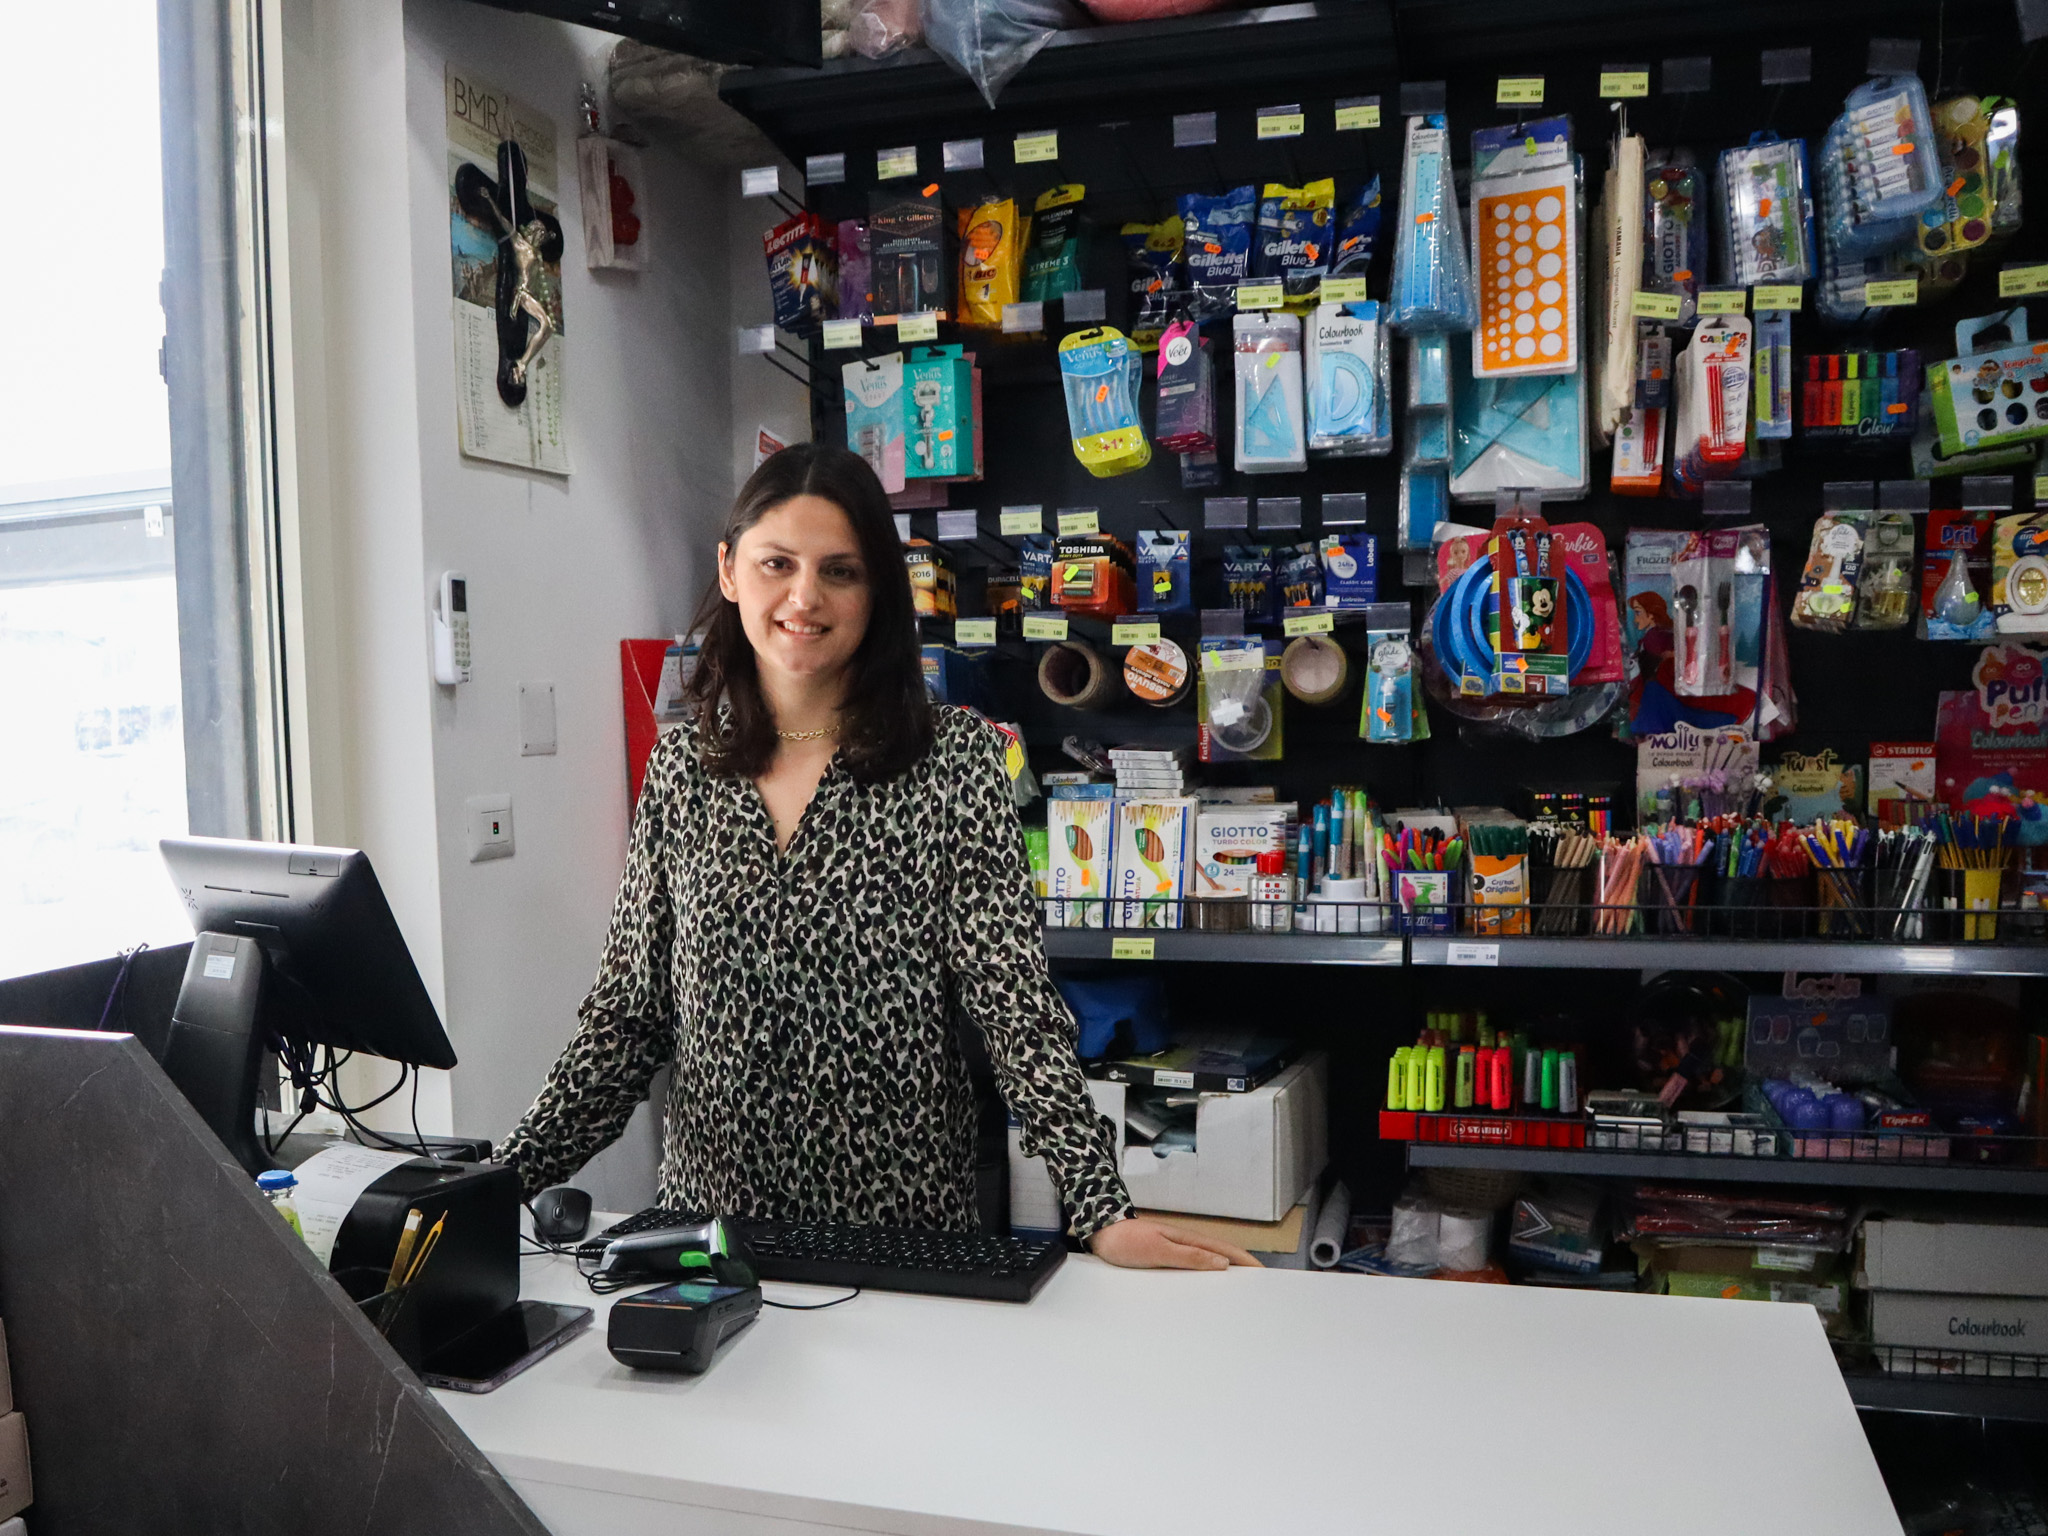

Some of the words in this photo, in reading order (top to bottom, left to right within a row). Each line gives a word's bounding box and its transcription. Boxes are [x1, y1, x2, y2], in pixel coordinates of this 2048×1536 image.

[454, 77, 501, 138] BMR
[877, 216, 896, 225] King
[906, 213, 934, 222] Gillette
[766, 222, 807, 253] LOCTITE
[1663, 220, 1674, 274] GIOTTO
[1029, 259, 1061, 272] XTREME
[1062, 256, 1069, 266] 3
[1188, 253, 1245, 267] Gillette
[973, 270, 996, 280] BIC
[1319, 325, 1364, 340] Colourbook
[1064, 348, 1103, 363] Venus
[1168, 345, 1188, 358] Veet
[913, 368, 942, 381] Venus
[860, 379, 888, 393] Venus
[1123, 417, 1130, 425] 4
[1857, 416, 1895, 436] Glow
[1941, 525, 1978, 544] Pril
[1059, 545, 1104, 554] TOSHIBA
[1138, 546, 1188, 556] VARTA
[1366, 538, 1375, 567] Labello
[1223, 562, 1272, 572] VARTA
[911, 570, 931, 579] 2016
[1887, 745, 1933, 755] STABILO
[1652, 757, 1694, 768] Colourbook
[1051, 776, 1078, 784] Colourbook
[1792, 784, 1825, 793] Colourbook
[1211, 826, 1268, 838] GIOTTO
[1223, 868, 1235, 877] 24
[1485, 886, 1520, 894] Original
[1884, 1116, 1926, 1126] Tipp-Ex
[1466, 1125, 1508, 1136] STABILO
[1949, 1316, 2027, 1338] Colourbook
